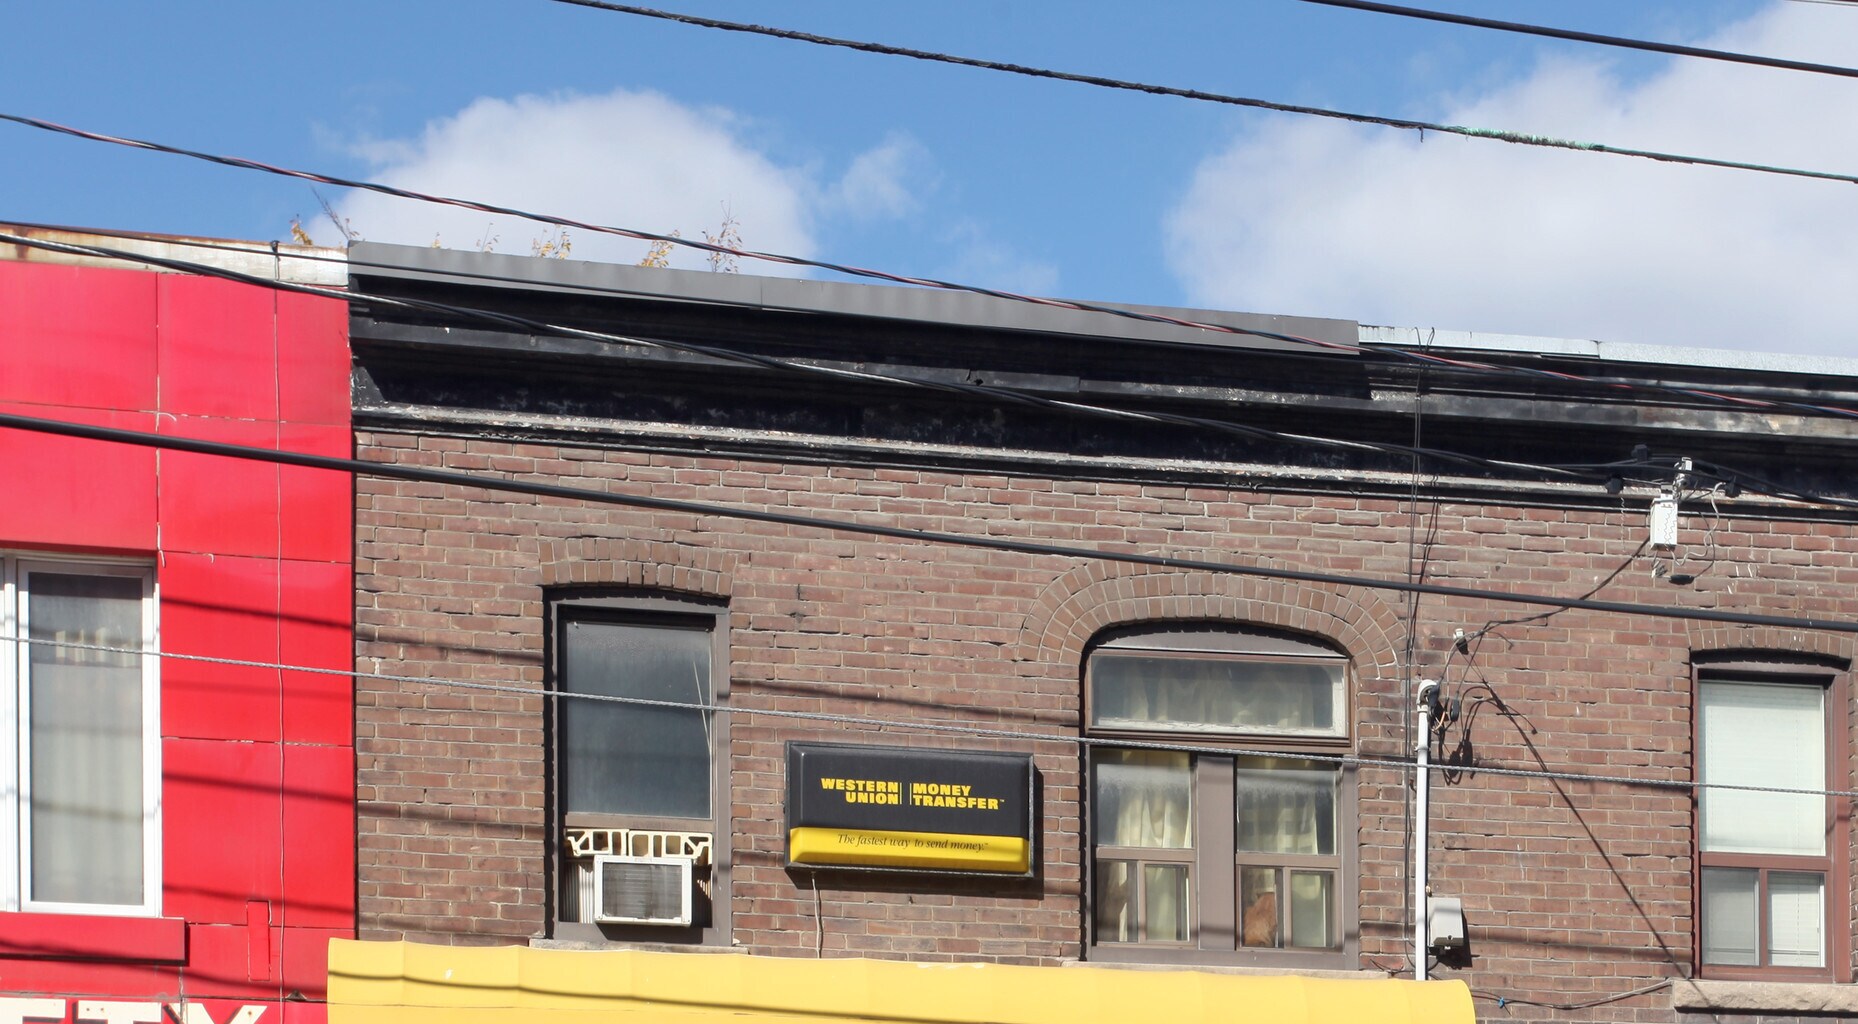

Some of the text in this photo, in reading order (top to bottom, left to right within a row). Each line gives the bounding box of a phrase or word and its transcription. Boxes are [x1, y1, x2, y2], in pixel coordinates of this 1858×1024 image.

[821, 778, 899, 793] WESTERN
[913, 783, 971, 796] MONEY
[845, 792, 899, 805] UNION
[913, 795, 998, 810] TRANSFER
[837, 833, 855, 844] The
[856, 835, 888, 847] fastest
[889, 838, 910, 849] way
[914, 838, 924, 848] to
[925, 838, 949, 849] send
